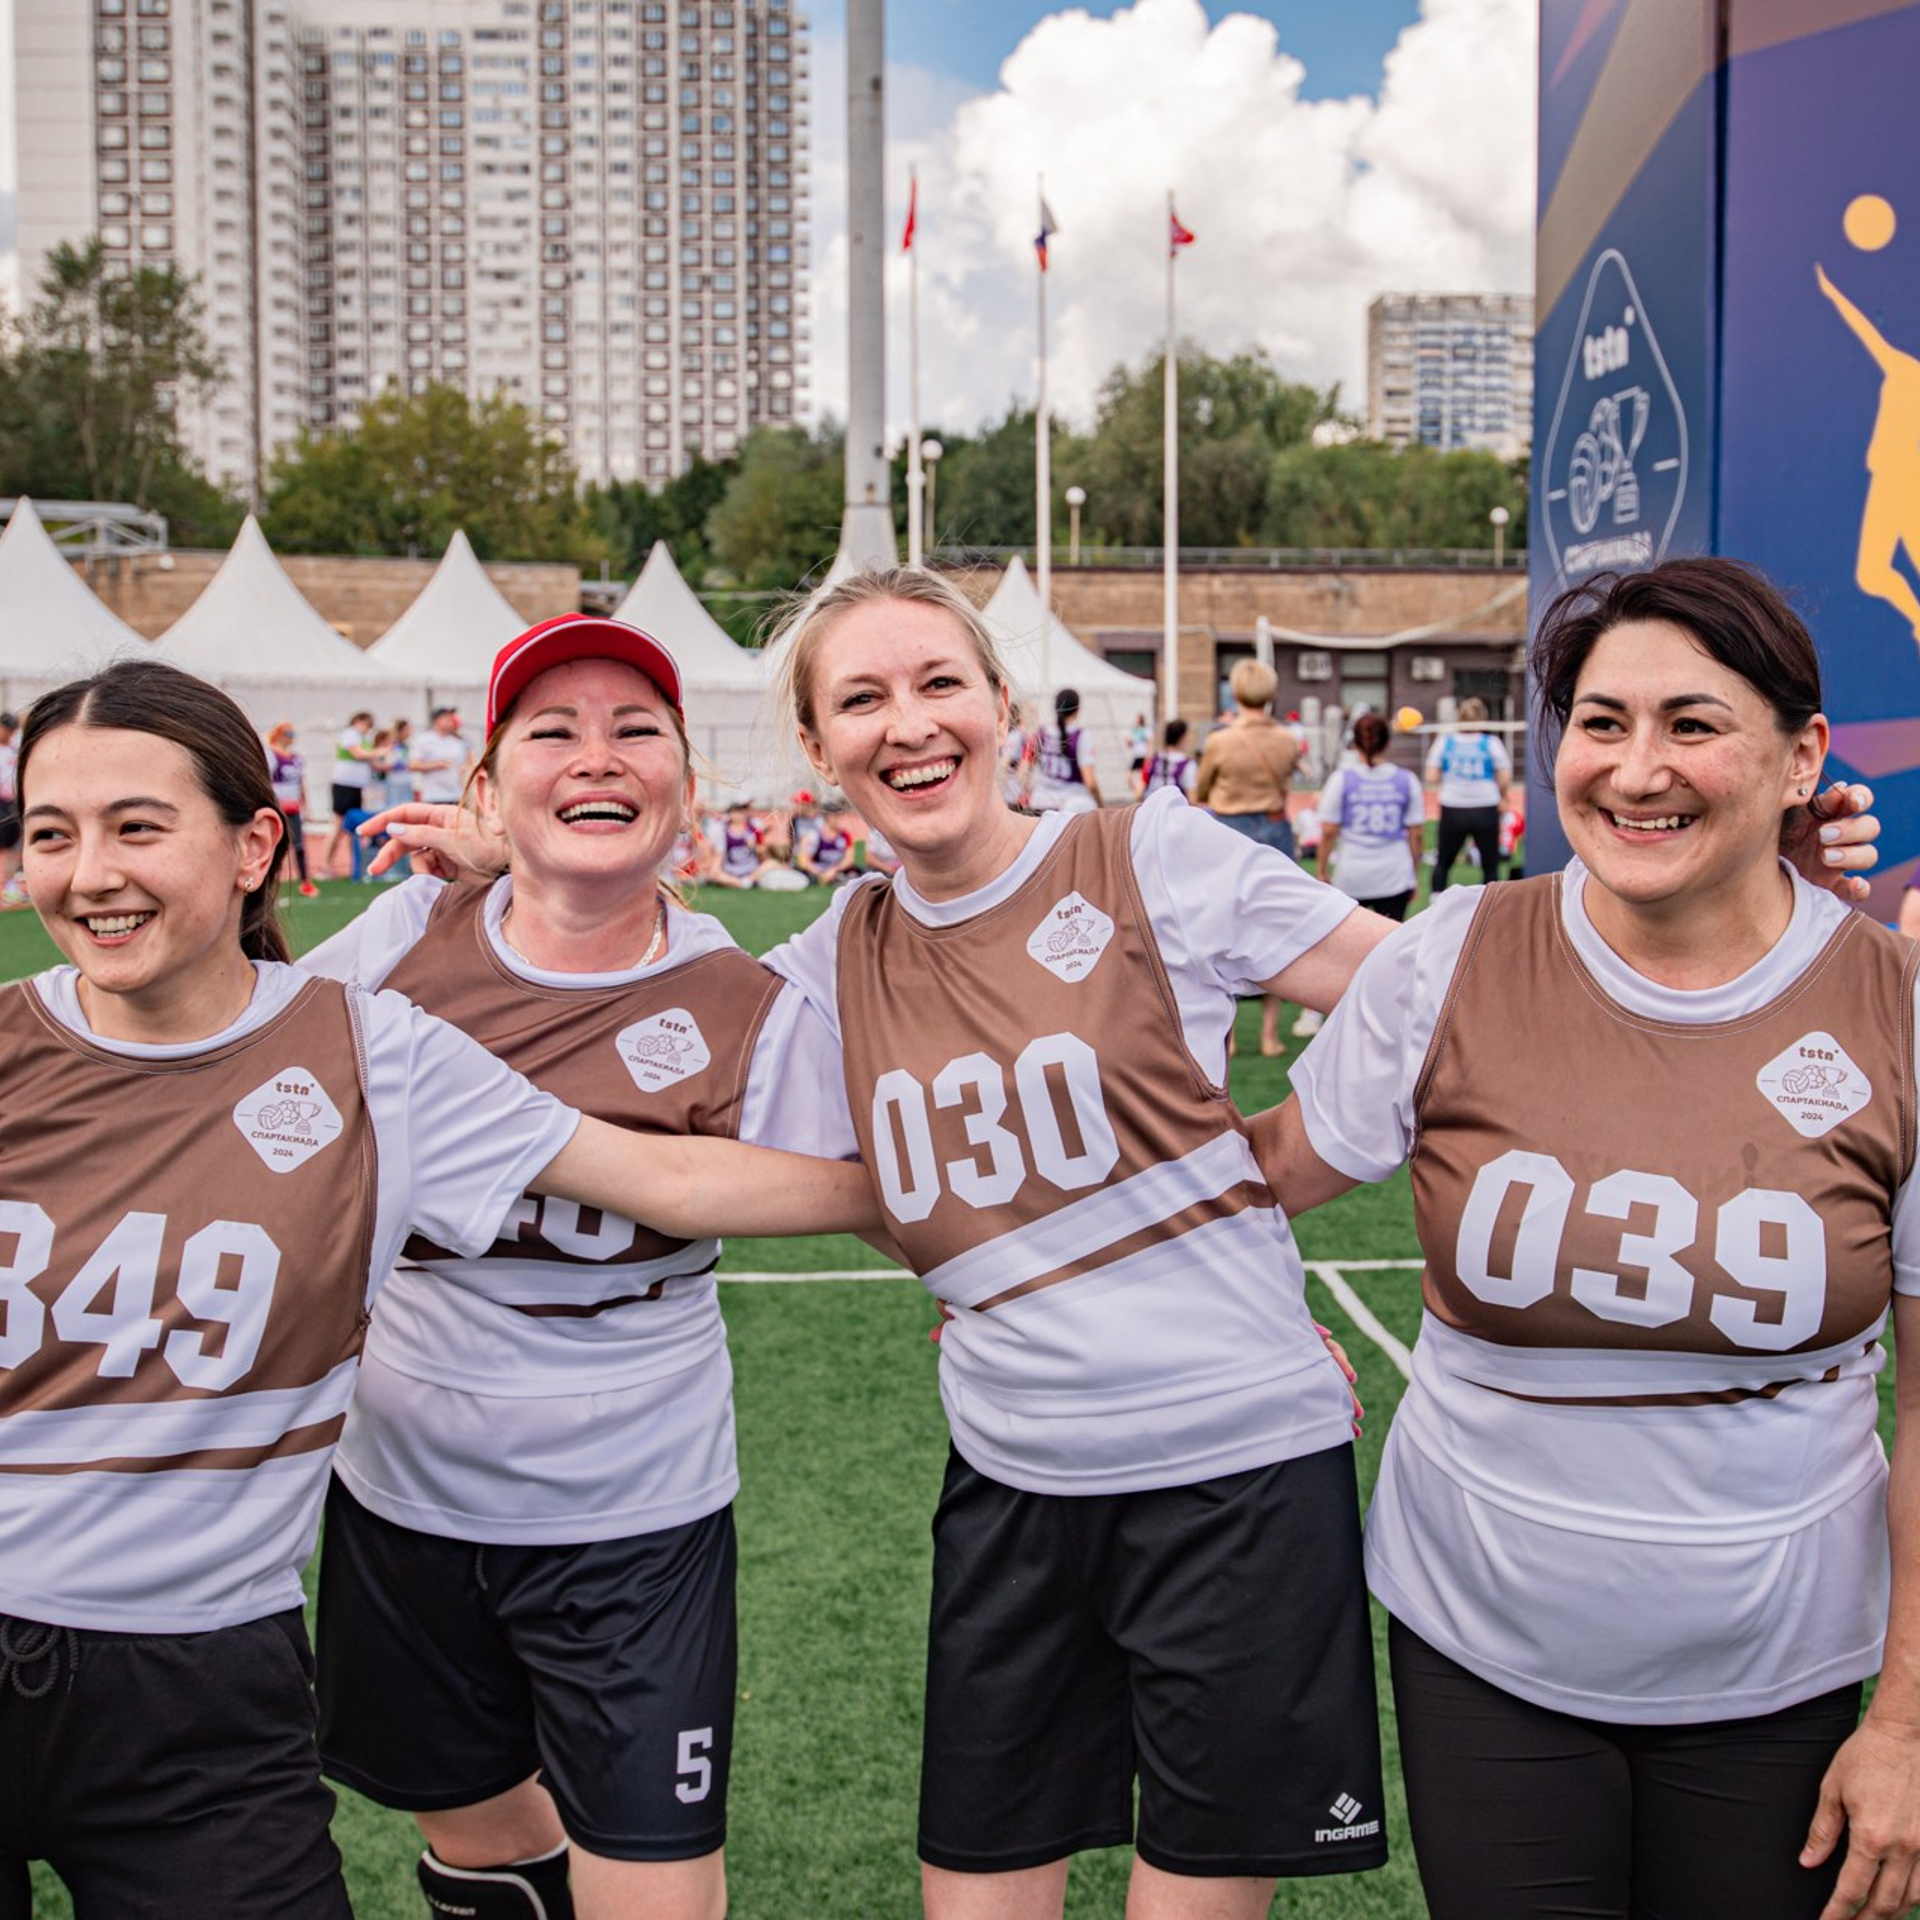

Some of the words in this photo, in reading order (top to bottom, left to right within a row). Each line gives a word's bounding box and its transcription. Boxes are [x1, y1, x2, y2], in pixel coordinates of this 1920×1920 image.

[658, 1017, 688, 1034] tstn
[1798, 1046, 1835, 1061] tstn
[275, 1081, 310, 1096] tstn
[1776, 1095, 1850, 1112] СПАРТАКИАДА
[1800, 1111, 1824, 1121] 2024
[872, 1031, 1121, 1225] 030
[250, 1130, 319, 1147] СПАРТАКИАДА
[272, 1147, 294, 1157] 2024
[1455, 1148, 1827, 1352] 039
[675, 1725, 713, 1804] 5
[1314, 1819, 1380, 1842] INGAME
